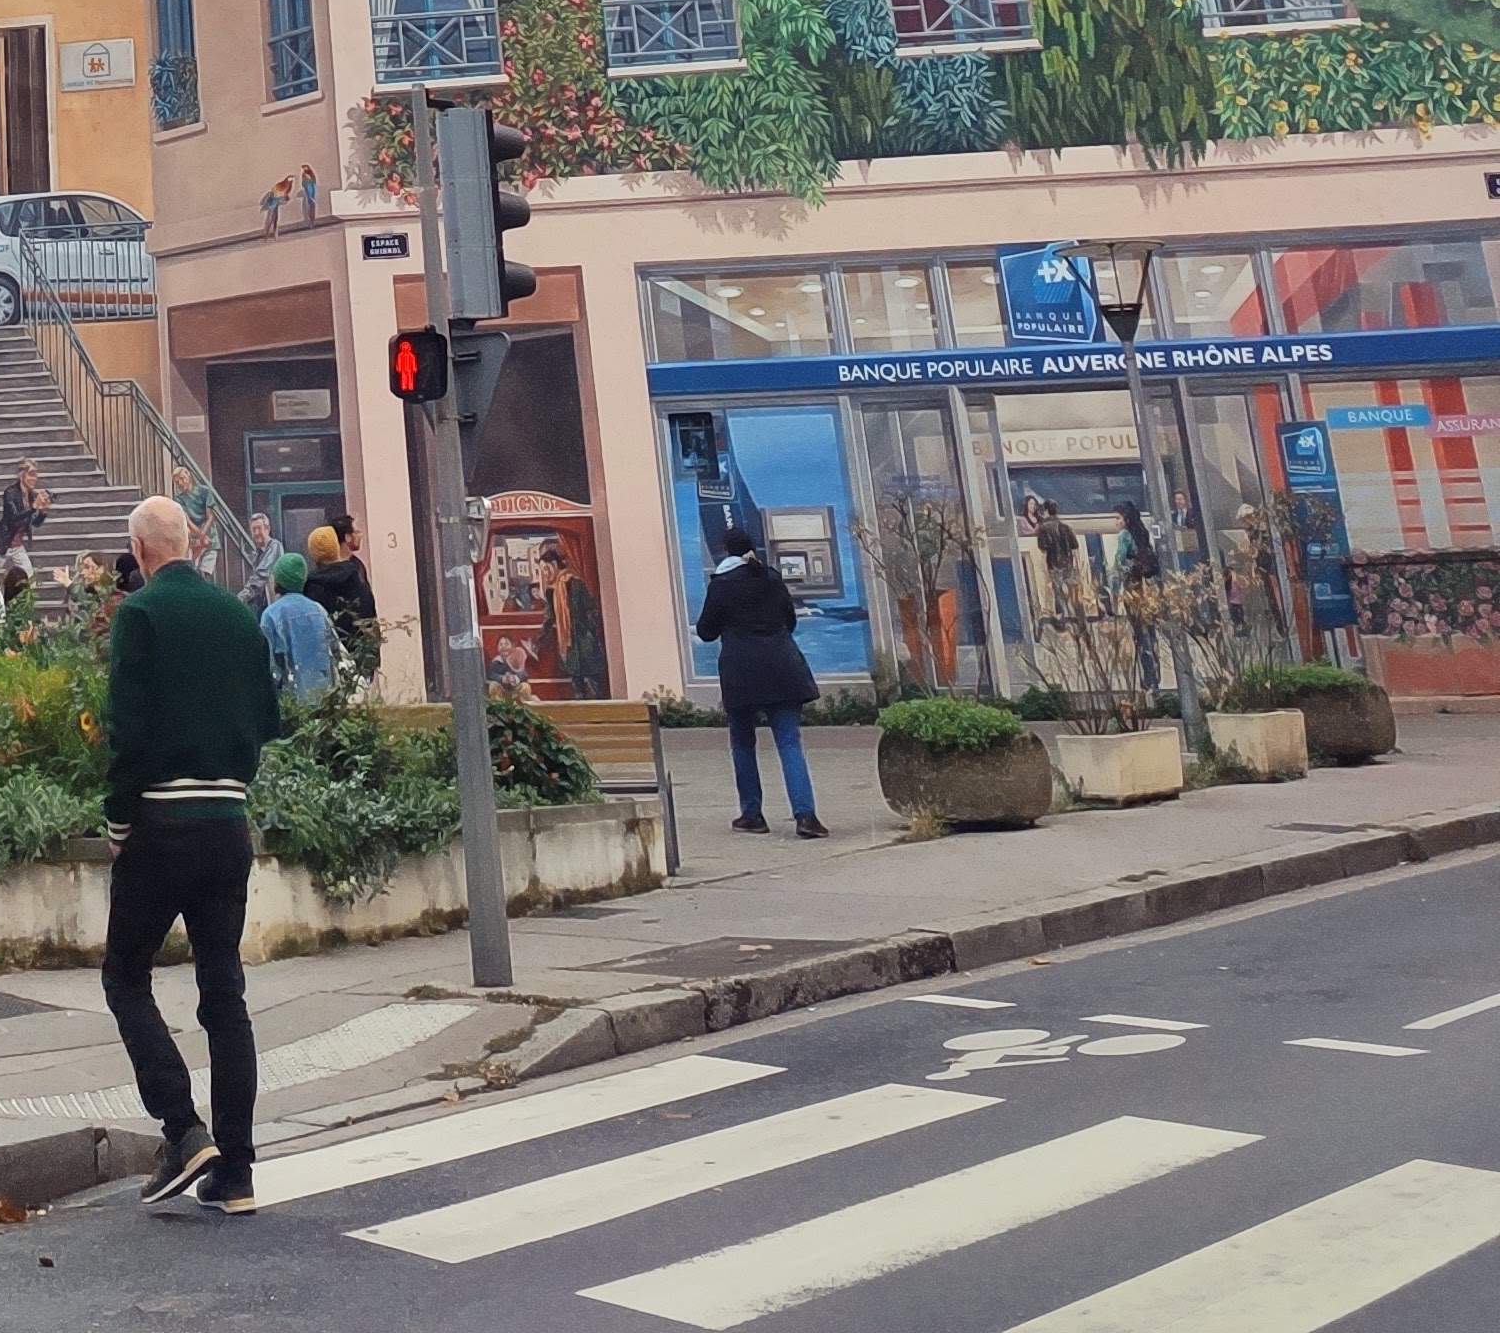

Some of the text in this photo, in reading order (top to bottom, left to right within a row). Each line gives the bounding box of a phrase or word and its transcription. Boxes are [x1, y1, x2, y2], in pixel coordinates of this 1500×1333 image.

[370, 238, 400, 247] ESPACE
[1015, 311, 1083, 322] BANQUE
[1017, 322, 1085, 334] POPULAIRE
[838, 362, 923, 383] BANQUE
[927, 357, 1034, 379] POPULAIRE
[1172, 344, 1254, 368] RHÔNE
[1261, 344, 1333, 364] ALPES
[1347, 408, 1414, 424] BANQUE
[387, 531, 398, 549] 3
